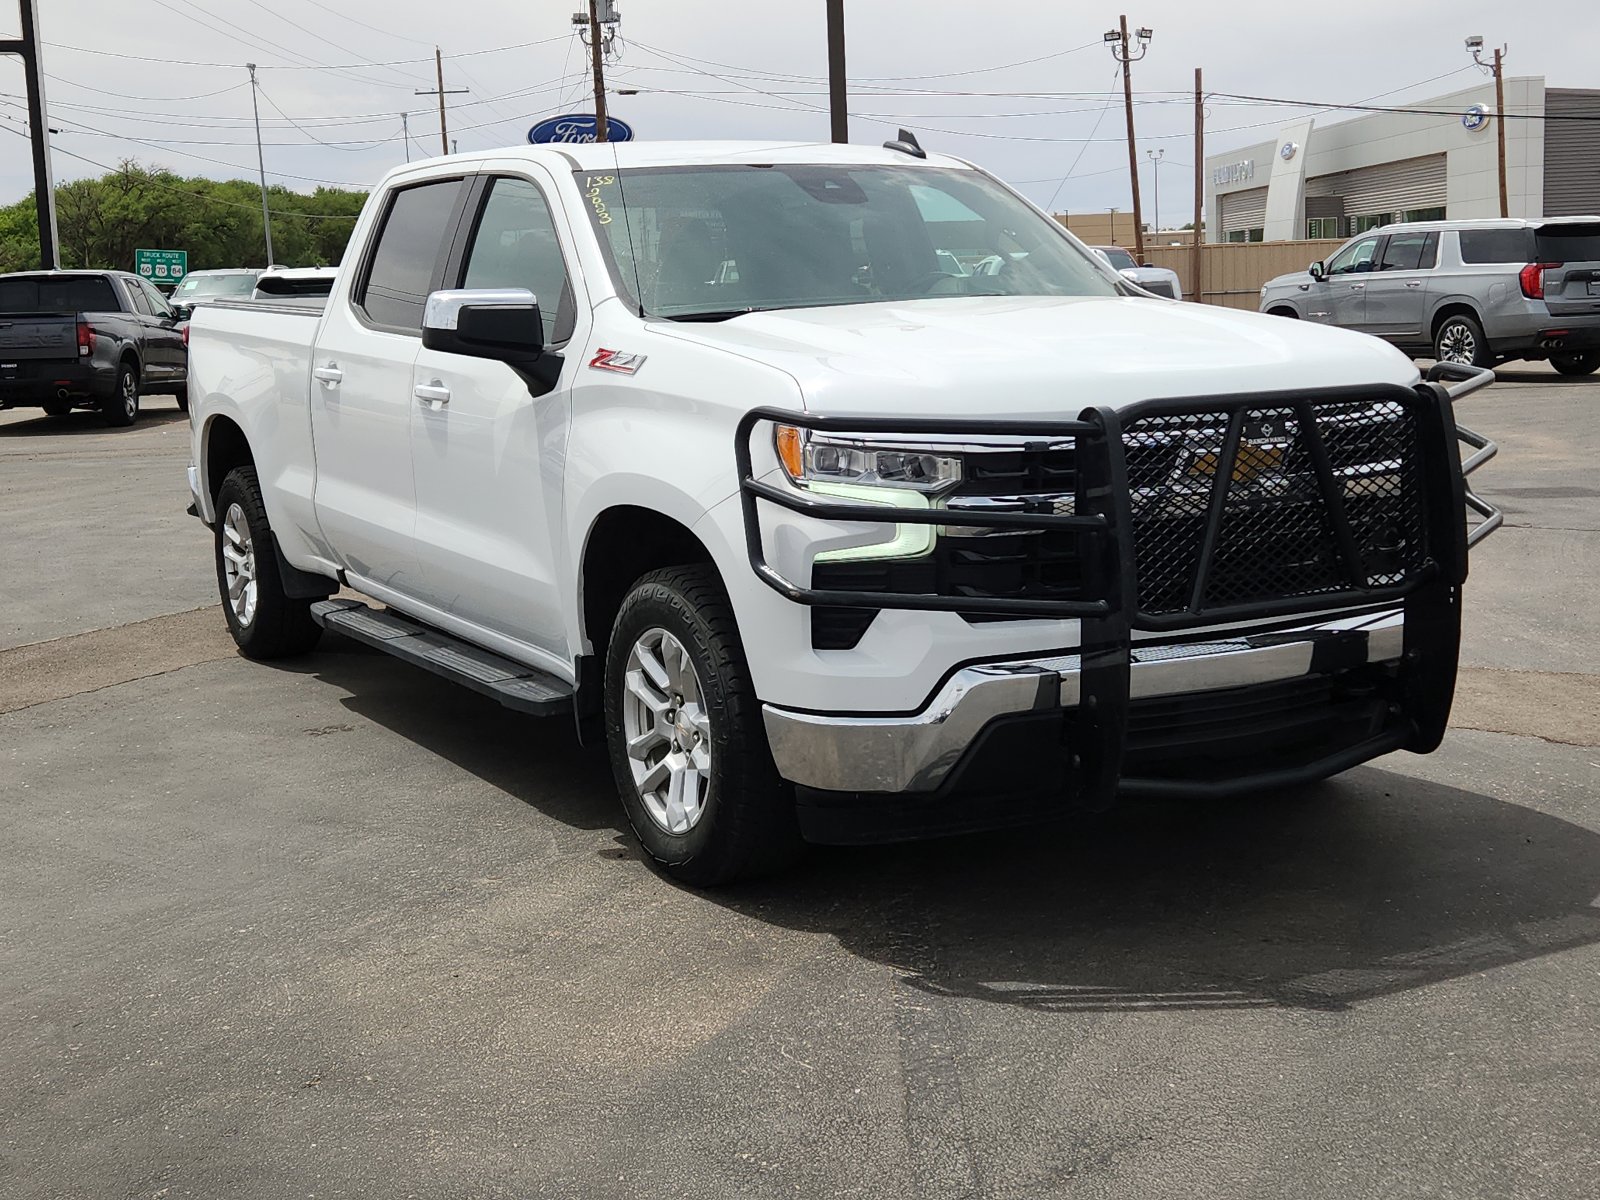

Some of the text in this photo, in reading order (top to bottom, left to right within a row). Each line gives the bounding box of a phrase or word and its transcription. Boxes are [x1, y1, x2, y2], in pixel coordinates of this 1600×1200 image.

[550, 122, 611, 143] For
[141, 266, 181, 275] 60 70 84
[588, 347, 648, 375] Z71
